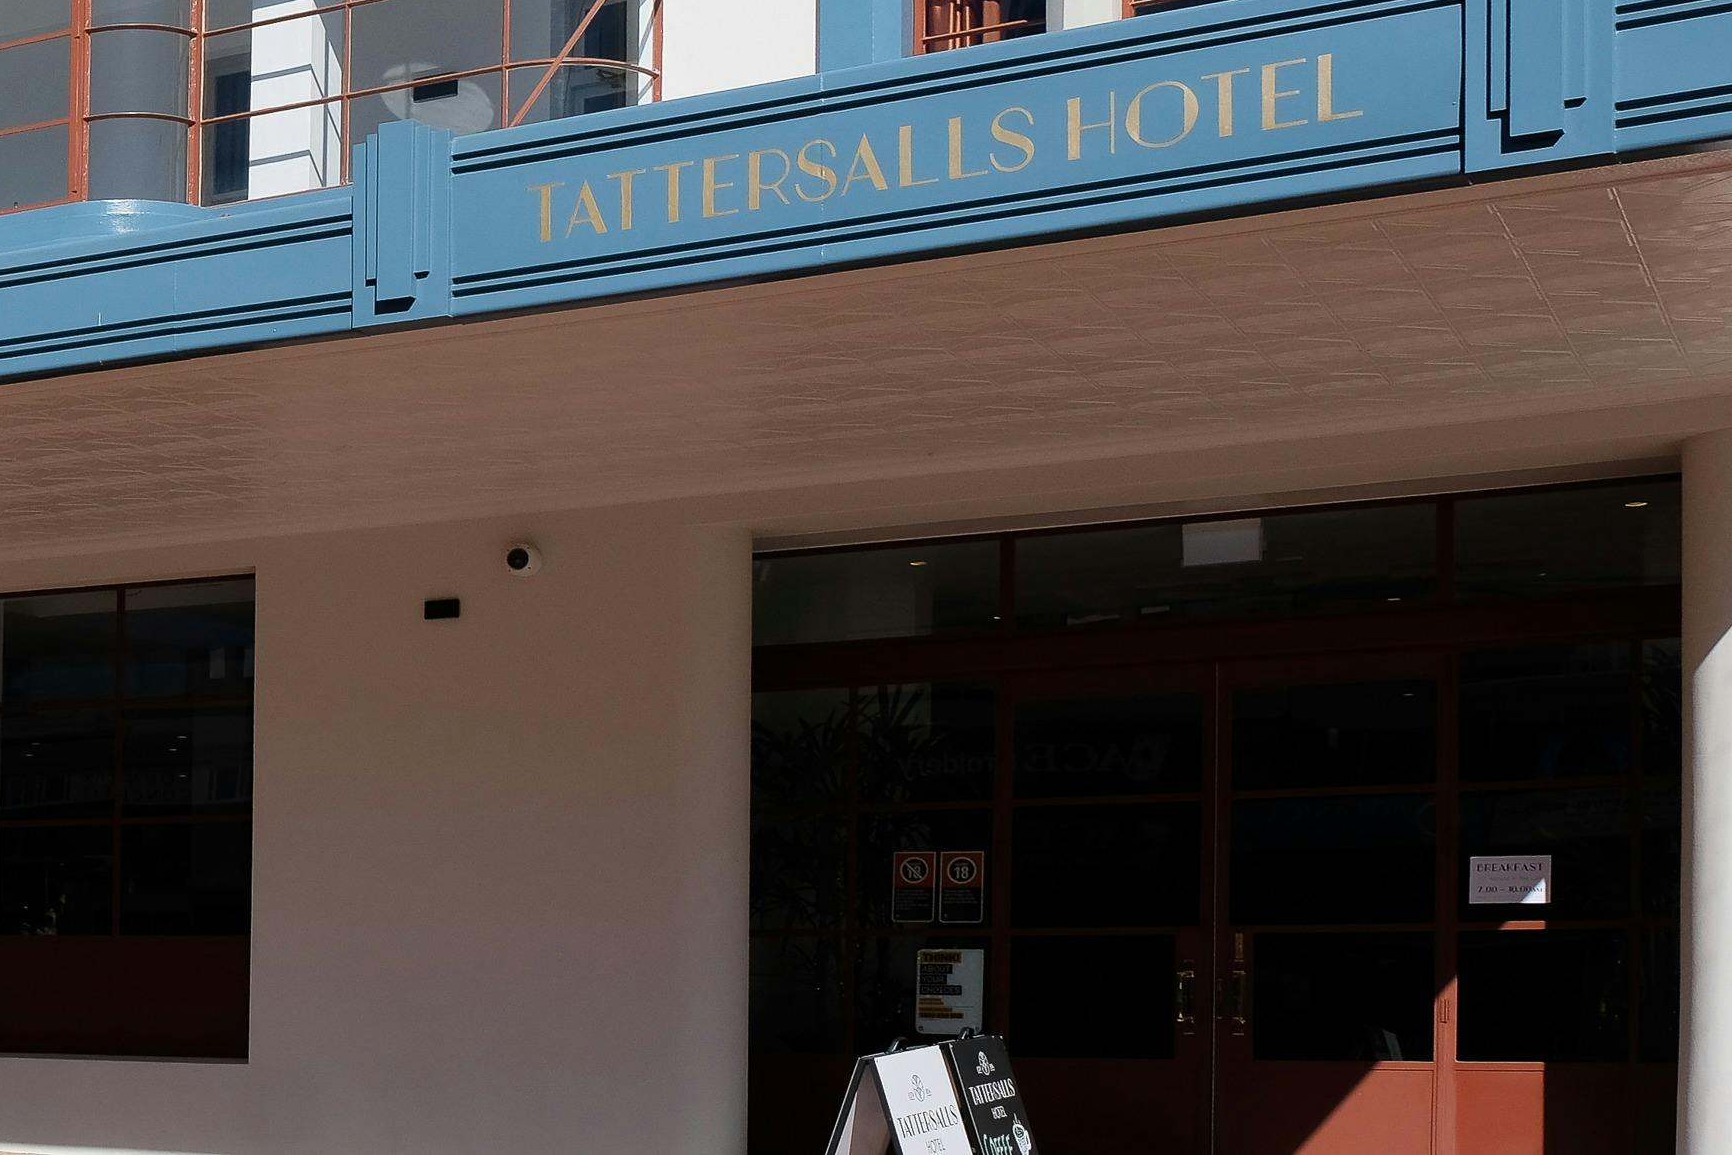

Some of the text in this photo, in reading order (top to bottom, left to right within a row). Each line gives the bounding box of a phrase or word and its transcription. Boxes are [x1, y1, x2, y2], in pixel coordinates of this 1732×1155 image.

[527, 53, 1364, 243] TATTERSALLS HOTEL
[954, 866, 970, 879] 18
[1476, 862, 1544, 872] BREAKFAST
[968, 1078, 1016, 1105] TATTERSALLS
[896, 1104, 959, 1139] TATTERSALLS
